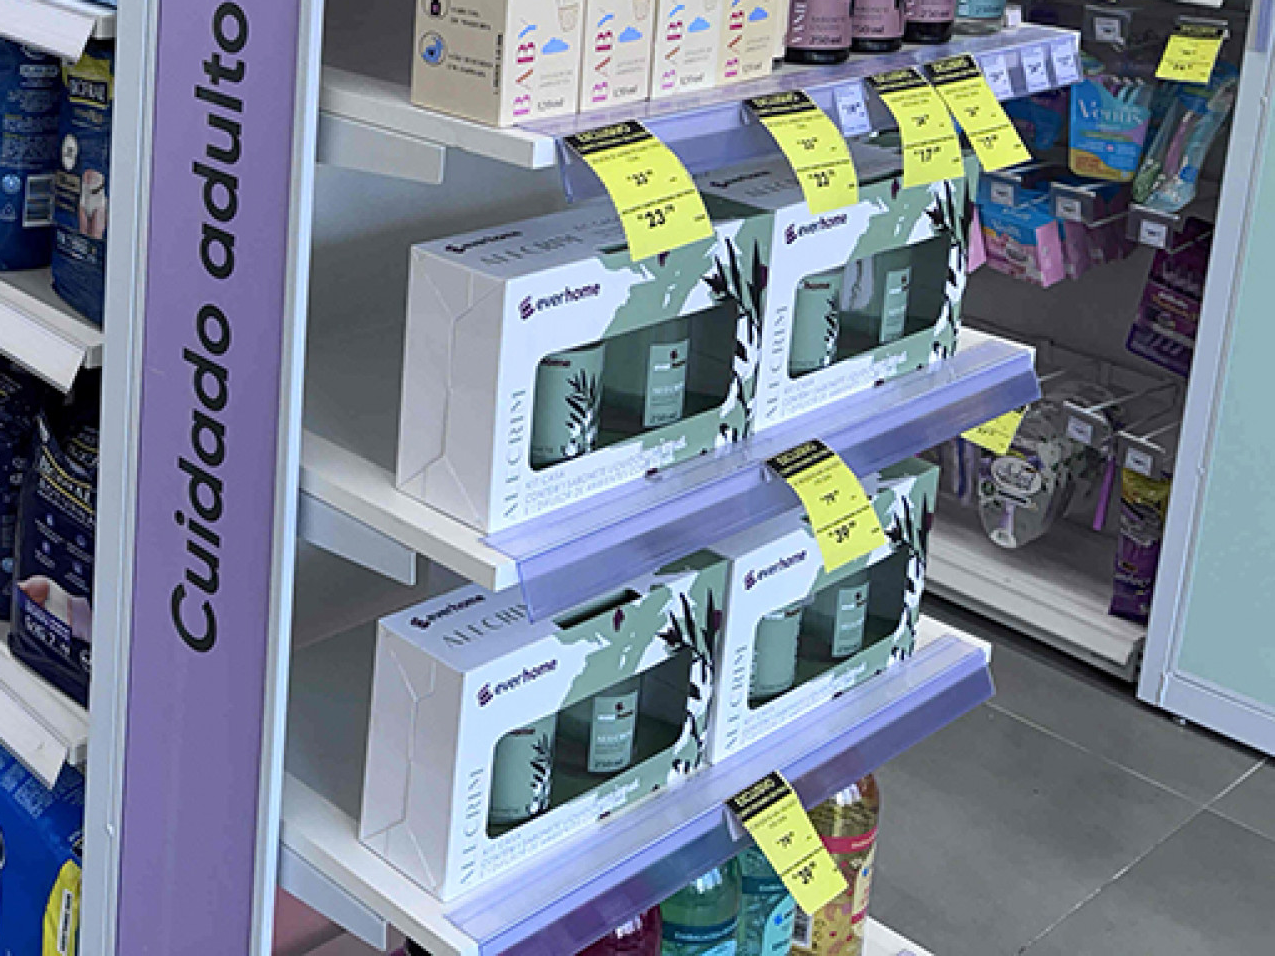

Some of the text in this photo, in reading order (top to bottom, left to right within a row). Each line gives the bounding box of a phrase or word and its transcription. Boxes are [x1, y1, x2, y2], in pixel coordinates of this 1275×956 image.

[1074, 95, 1148, 124] Venus
[644, 210, 666, 229] 23
[798, 214, 848, 237] everhome
[536, 282, 601, 312] everhome
[169, 0, 250, 653] Cuidado adulto
[757, 550, 807, 582] everhome
[494, 658, 558, 696] everhome
